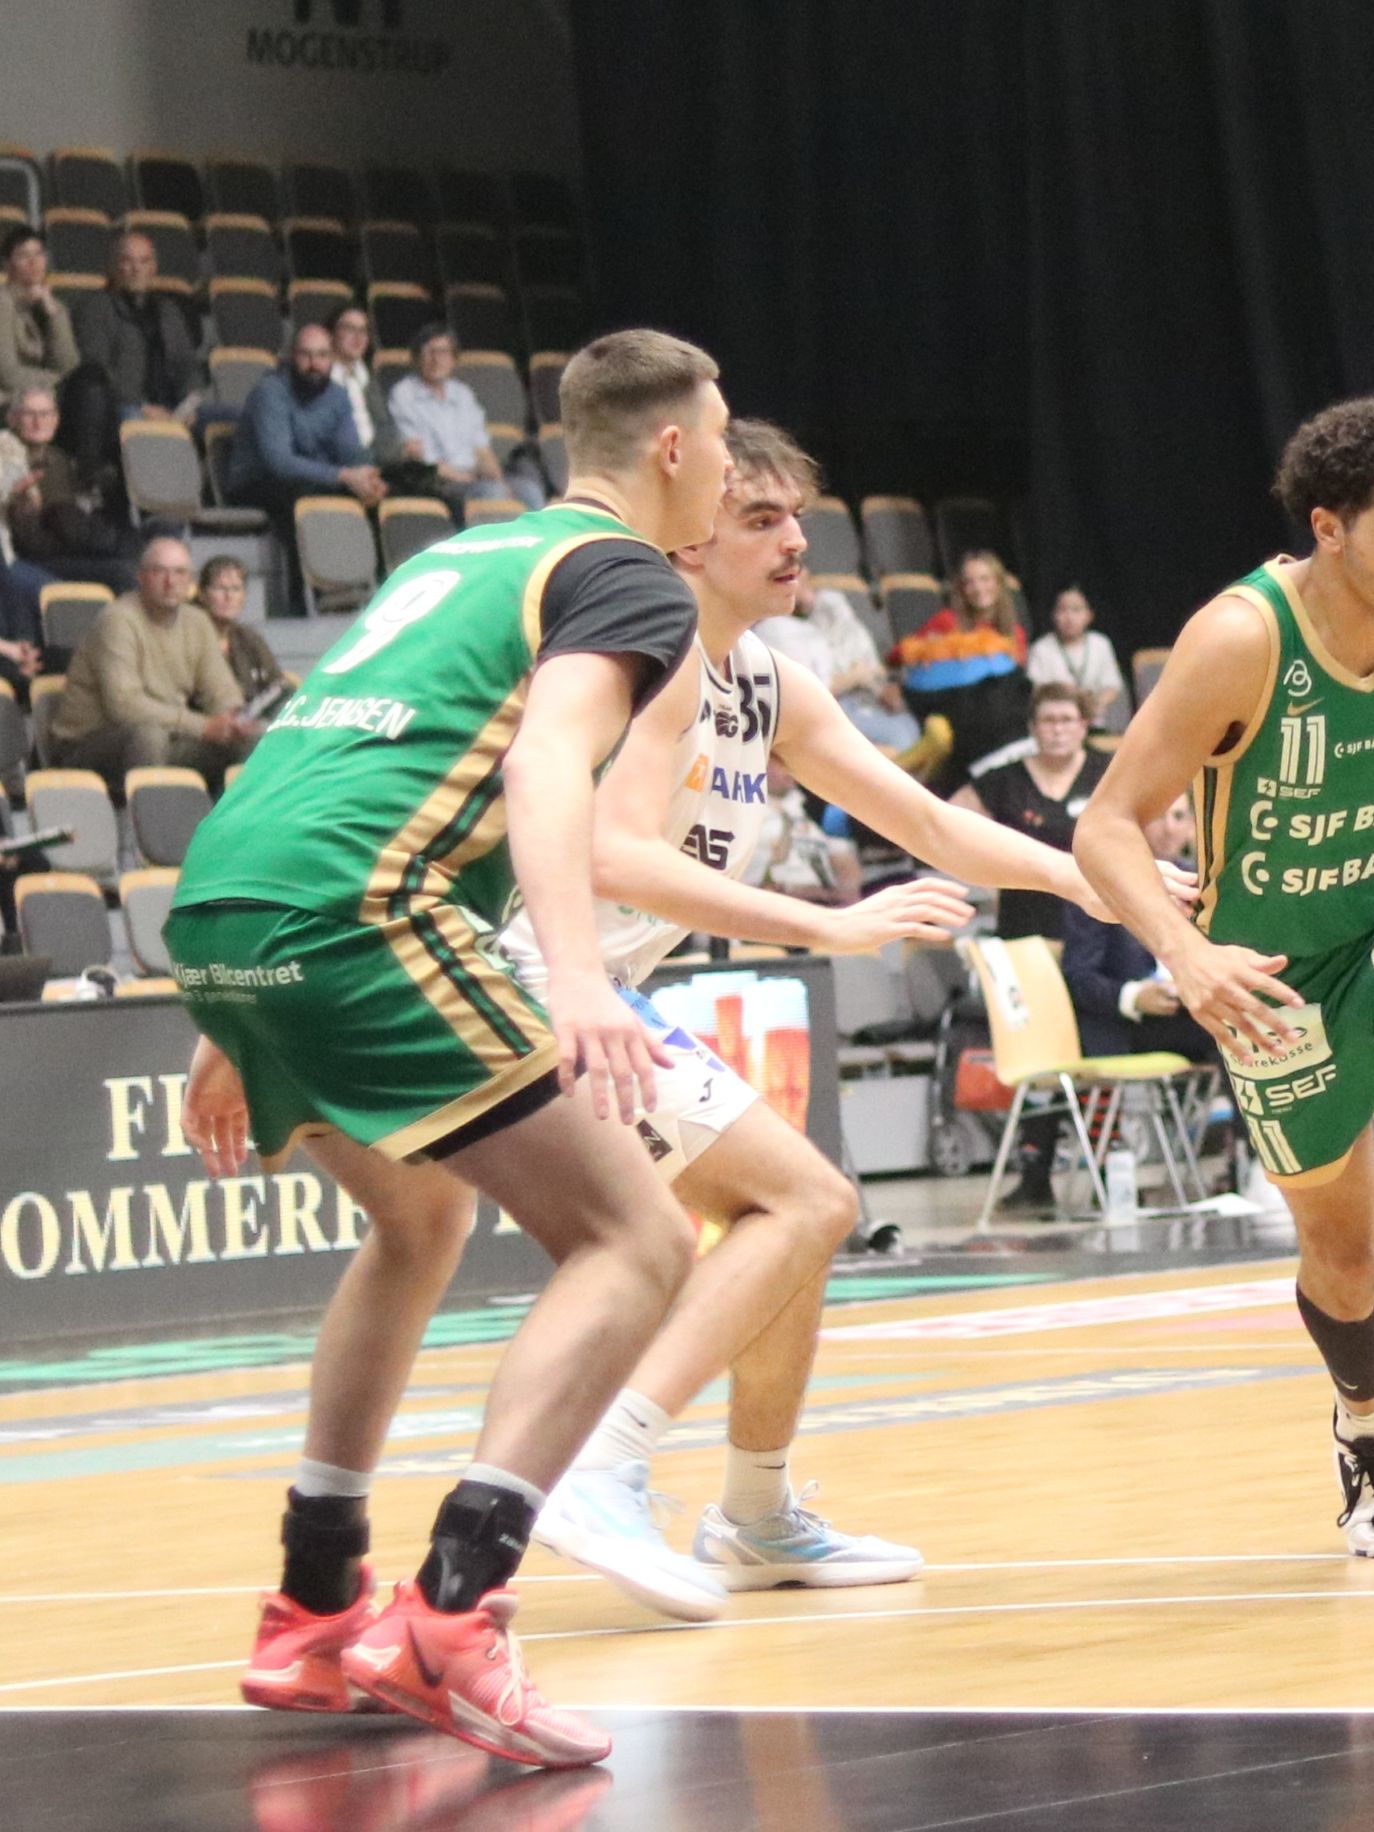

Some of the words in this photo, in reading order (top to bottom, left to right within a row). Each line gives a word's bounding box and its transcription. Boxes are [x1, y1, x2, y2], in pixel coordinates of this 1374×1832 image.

[322, 570, 461, 674] 9
[1279, 715, 1326, 784] 11
[1347, 742, 1363, 755] SJF
[1279, 787, 1321, 799] SEF
[1289, 810, 1347, 846] SJF
[1282, 867, 1339, 896] SJF
[1265, 1064, 1336, 1107] SEF
[1246, 1116, 1302, 1174] 11
